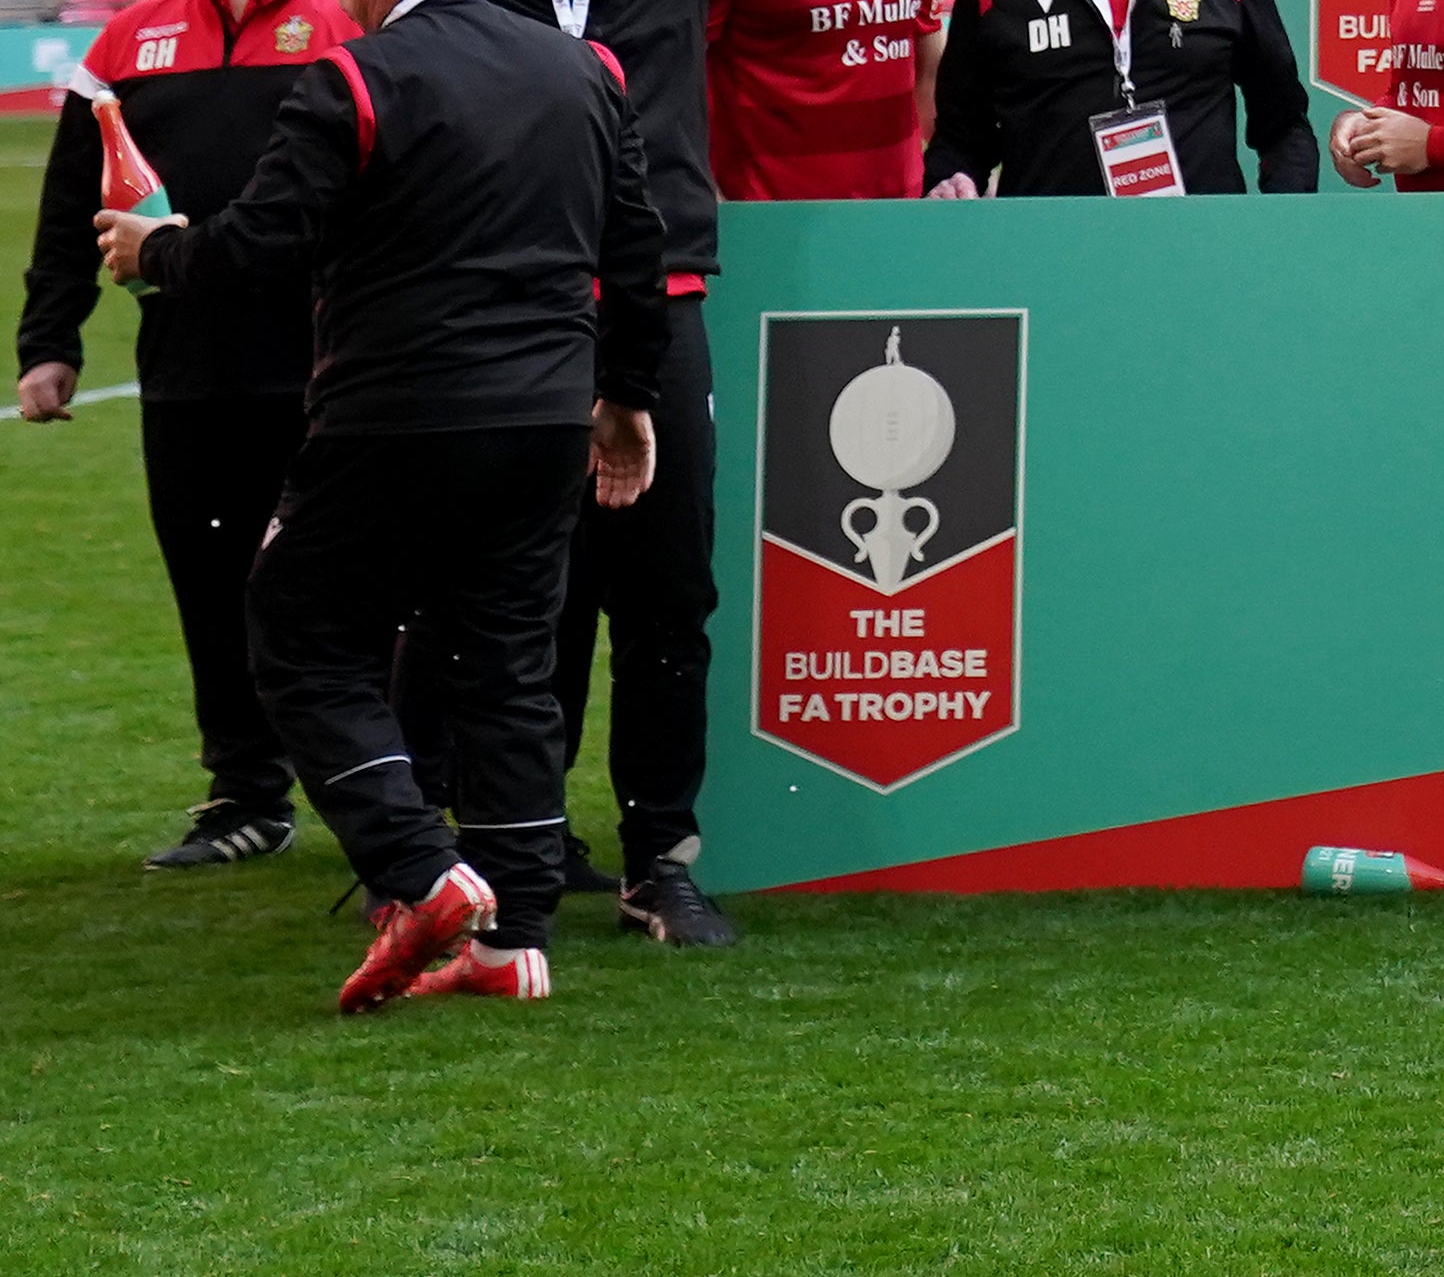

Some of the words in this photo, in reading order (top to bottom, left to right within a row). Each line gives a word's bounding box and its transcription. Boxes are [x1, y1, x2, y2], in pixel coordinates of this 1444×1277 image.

[810, 3, 852, 34] BF
[1028, 12, 1072, 54] DH
[136, 36, 178, 73] GH
[841, 38, 868, 67] &
[873, 34, 911, 63] Son
[1413, 81, 1440, 109] Son
[1139, 161, 1172, 182] ZONE
[849, 608, 925, 638] THE
[784, 649, 987, 681] BUILDBASE
[778, 692, 830, 723] FA
[834, 691, 991, 722] TROPHY
